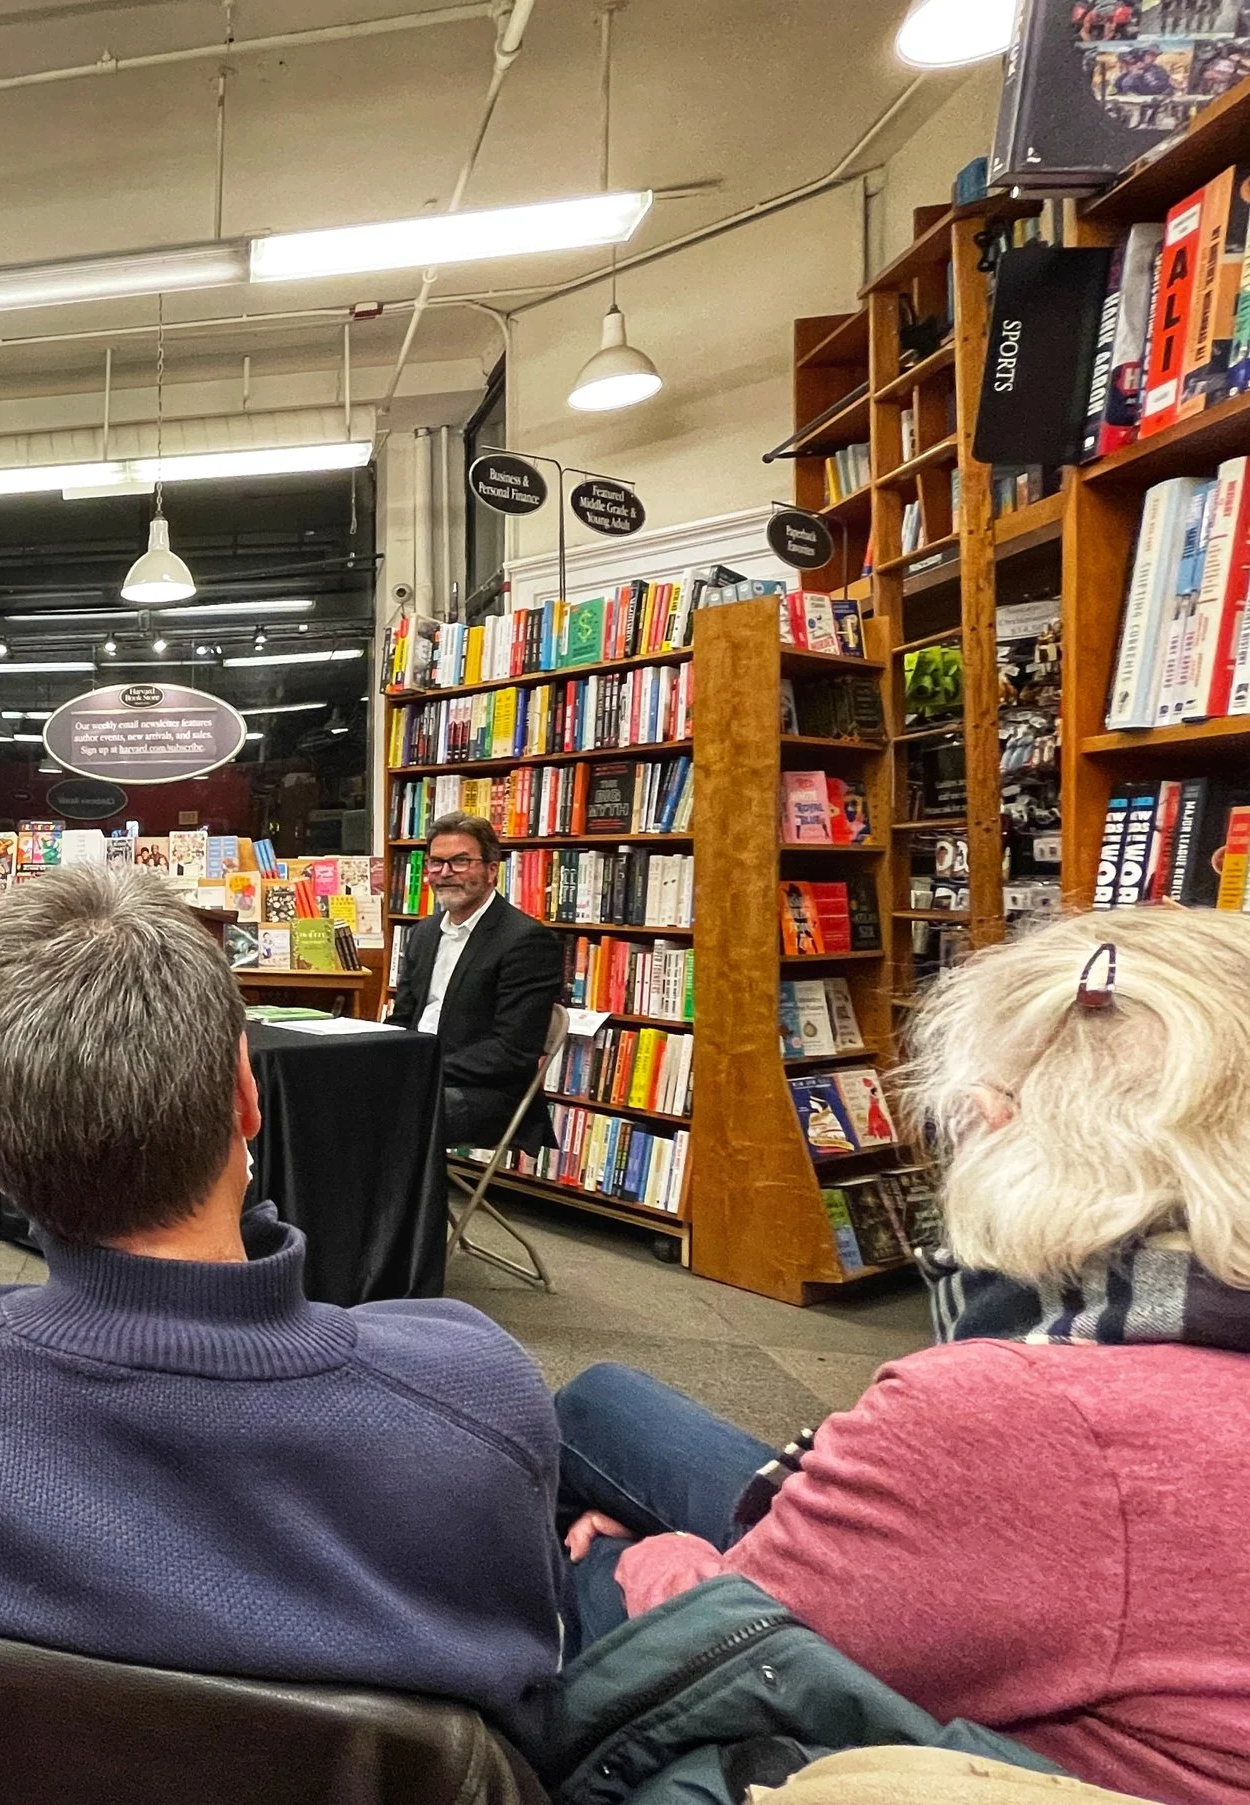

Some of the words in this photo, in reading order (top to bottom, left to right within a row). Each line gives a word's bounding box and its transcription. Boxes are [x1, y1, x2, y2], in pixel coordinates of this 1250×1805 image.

[1097, 291, 1120, 349] HANK
[1161, 246, 1189, 373] ALI
[993, 319, 1023, 393] SPORTS
[1086, 351, 1113, 417] AARON
[489, 468, 522, 484] Business
[522, 475, 530, 488] &
[478, 481, 510, 499] Personal
[511, 488, 540, 506] Finance
[592, 485, 625, 502] Featured
[579, 496, 605, 511] Middle
[606, 502, 630, 518] Grade
[630, 506, 637, 518] &
[586, 511, 611, 530] Young
[611, 516, 631, 531] Adult
[785, 524, 818, 543] Paperback
[1131, 561, 1151, 619] SHIFTING
[1121, 624, 1140, 683] CURRENTS
[125, 694, 142, 702] Book
[129, 687, 156, 695] Harvard
[75, 721, 90, 731] Our
[91, 720, 117, 731] weekly
[118, 719, 139, 729] email
[140, 719, 180, 728] newsletter
[181, 718, 213, 727] features
[74, 733, 99, 743] author
[99, 734, 126, 743] events,
[127, 733, 143, 741] new
[145, 731, 175, 741] arrivals,
[175, 731, 191, 740] and
[192, 730, 213, 739] sales.
[80, 745, 97, 755] Sign
[98, 746, 109, 755] up
[110, 745, 118, 753] at
[1179, 800, 1197, 833] MAJOR
[1174, 833, 1191, 868] LEAGUE
[1170, 868, 1186, 901] REBELS
